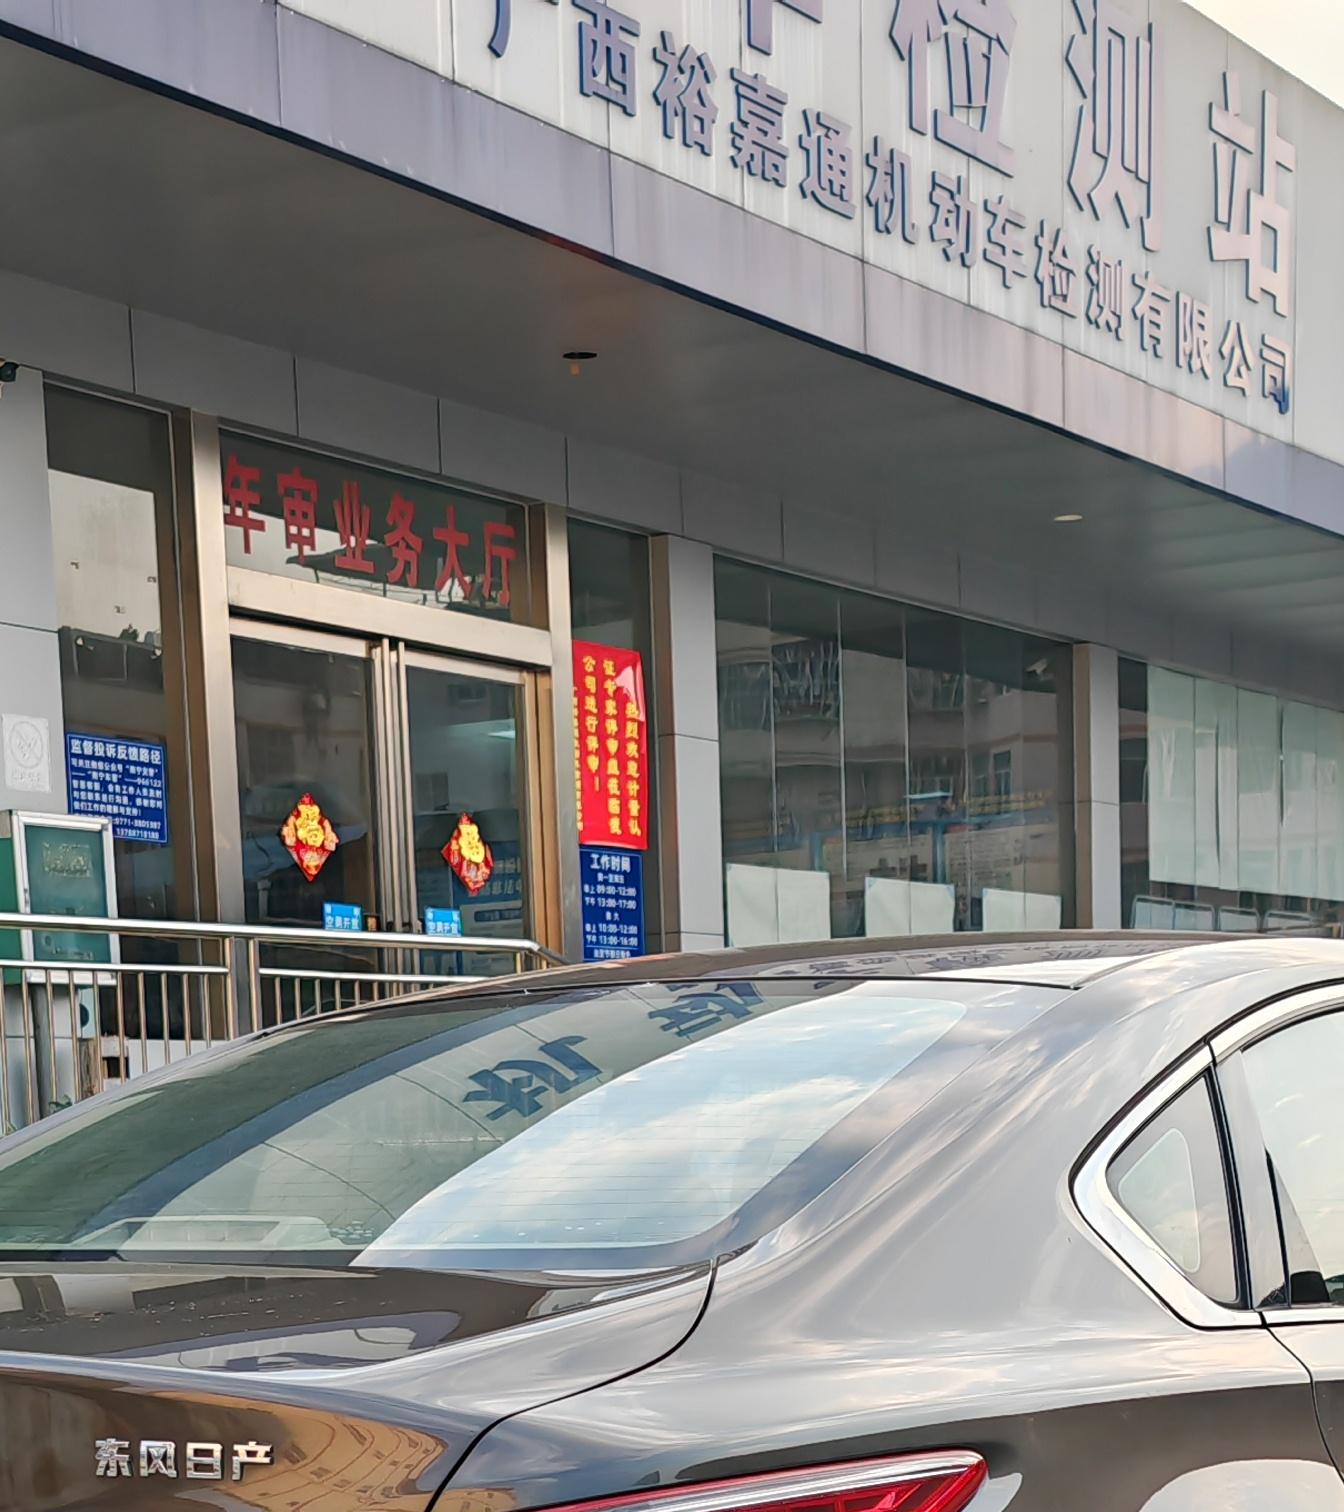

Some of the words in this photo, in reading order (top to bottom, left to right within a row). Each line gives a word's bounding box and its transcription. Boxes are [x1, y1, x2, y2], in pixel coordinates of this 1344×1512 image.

[746, 0, 1298, 318] 检测站
[222, 455, 517, 605] 年审业务大厅
[590, 853, 631, 873] 工作时间
[95, 1438, 273, 1481] 东风日产
